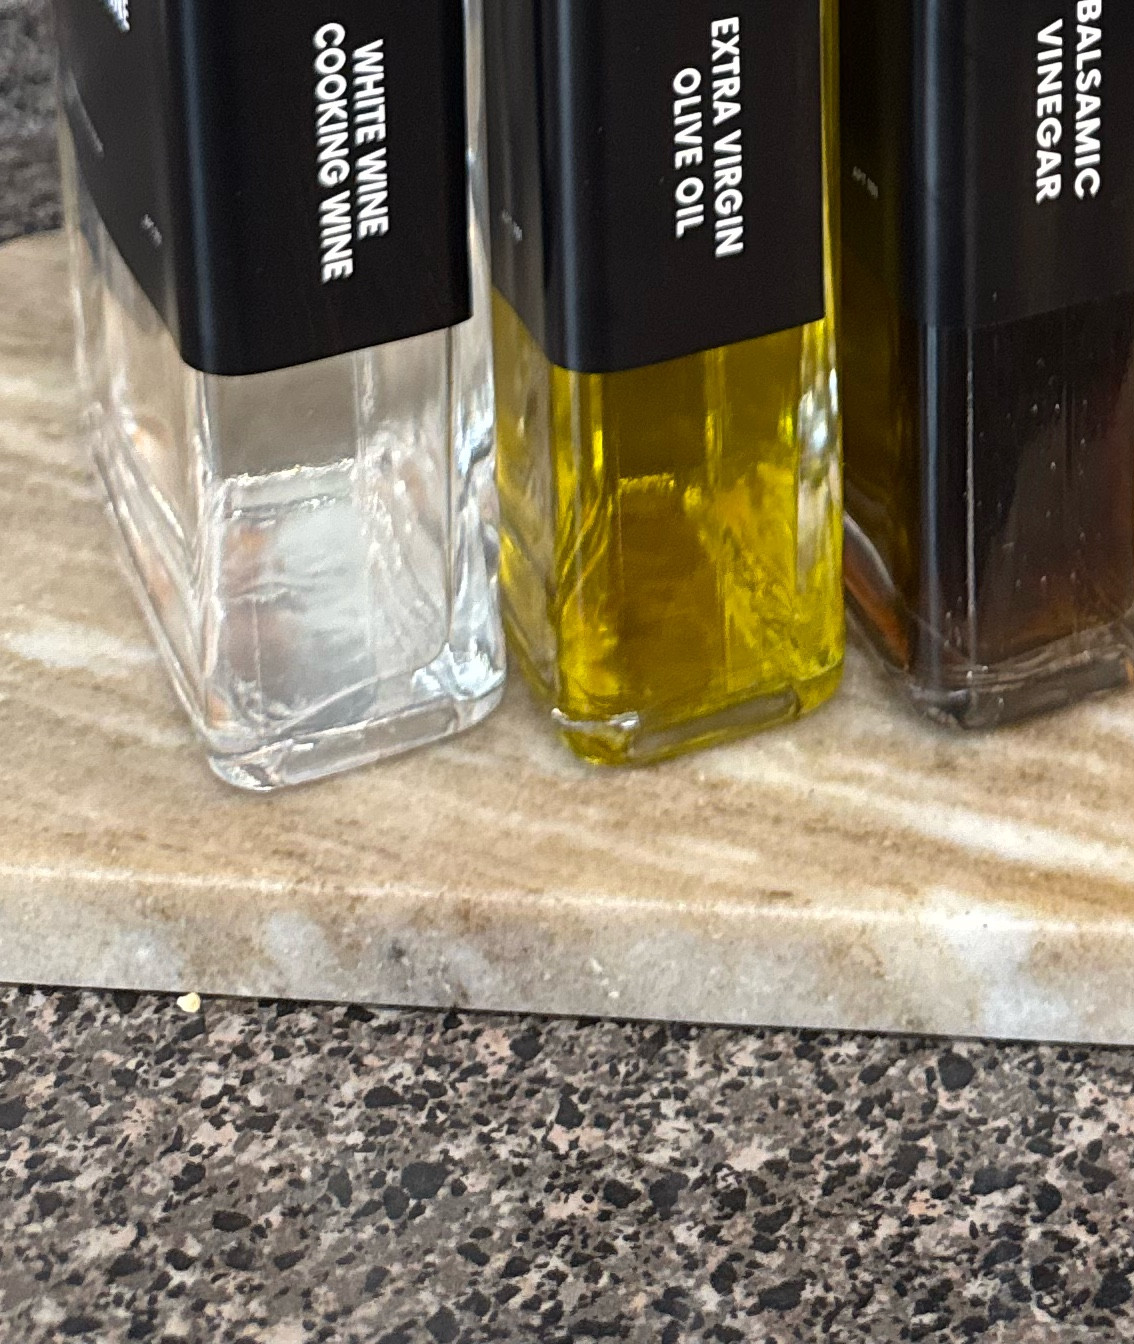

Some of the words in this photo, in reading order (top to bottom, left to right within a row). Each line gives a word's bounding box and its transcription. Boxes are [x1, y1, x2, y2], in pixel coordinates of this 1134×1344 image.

[313, 22, 352, 187] COOKING
[352, 38, 387, 145] WHITE
[672, 67, 703, 170] OLIVE
[710, 16, 742, 126] EXTRA
[1035, 18, 1063, 204] VINEGAR
[319, 189, 354, 283] WINE
[355, 147, 389, 239] WINE
[674, 176, 705, 238] OIL
[713, 128, 744, 258] VIRGIN
